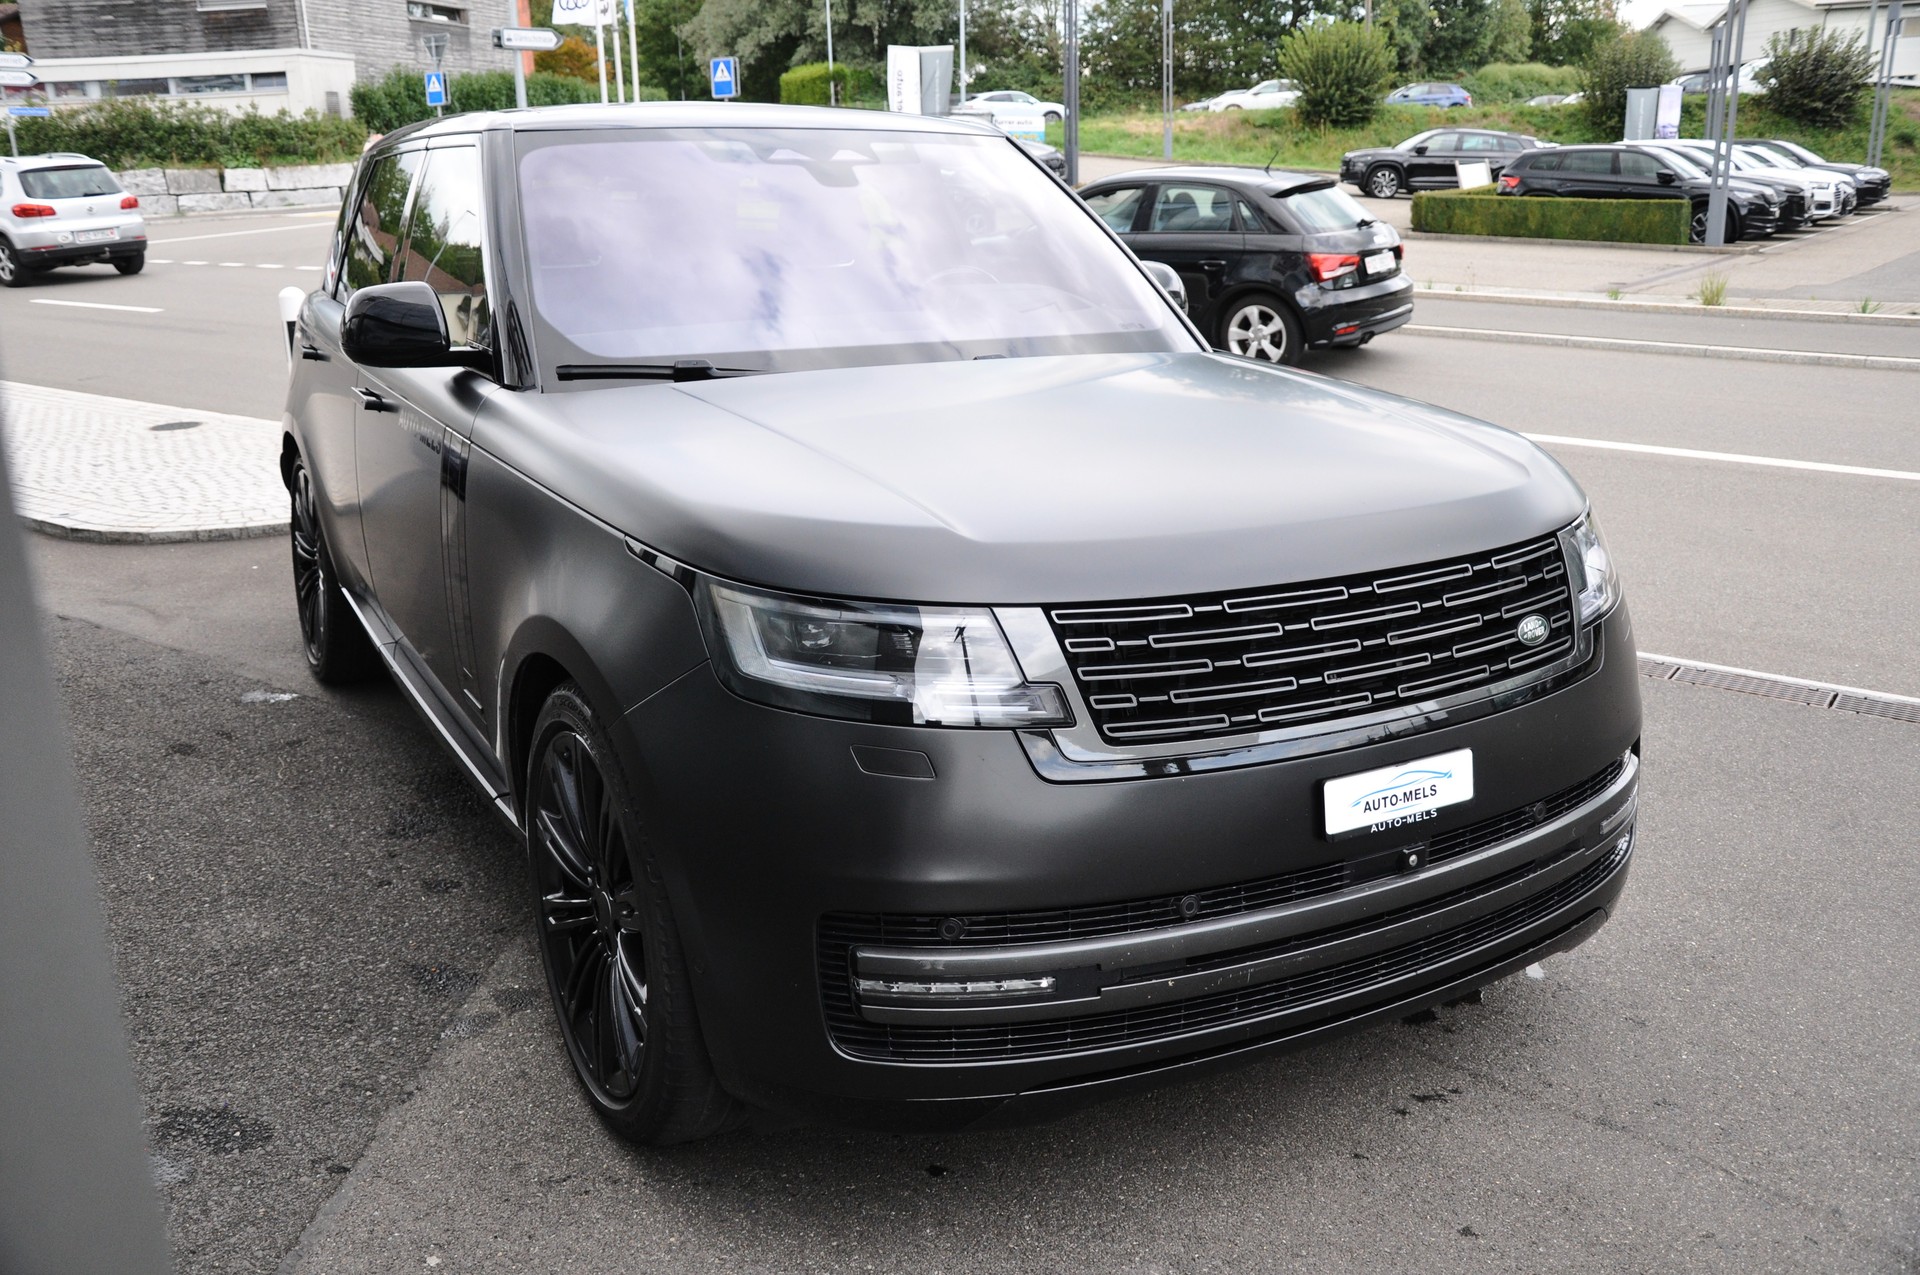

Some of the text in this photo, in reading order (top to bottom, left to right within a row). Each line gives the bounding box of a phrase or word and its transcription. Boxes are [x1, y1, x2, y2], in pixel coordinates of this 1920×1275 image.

[1523, 620, 1541, 633] LAND
[1527, 626, 1546, 640] ROVER
[1363, 784, 1438, 814] AUTO-MELS
[1370, 808, 1438, 834] AUTO-MELS
